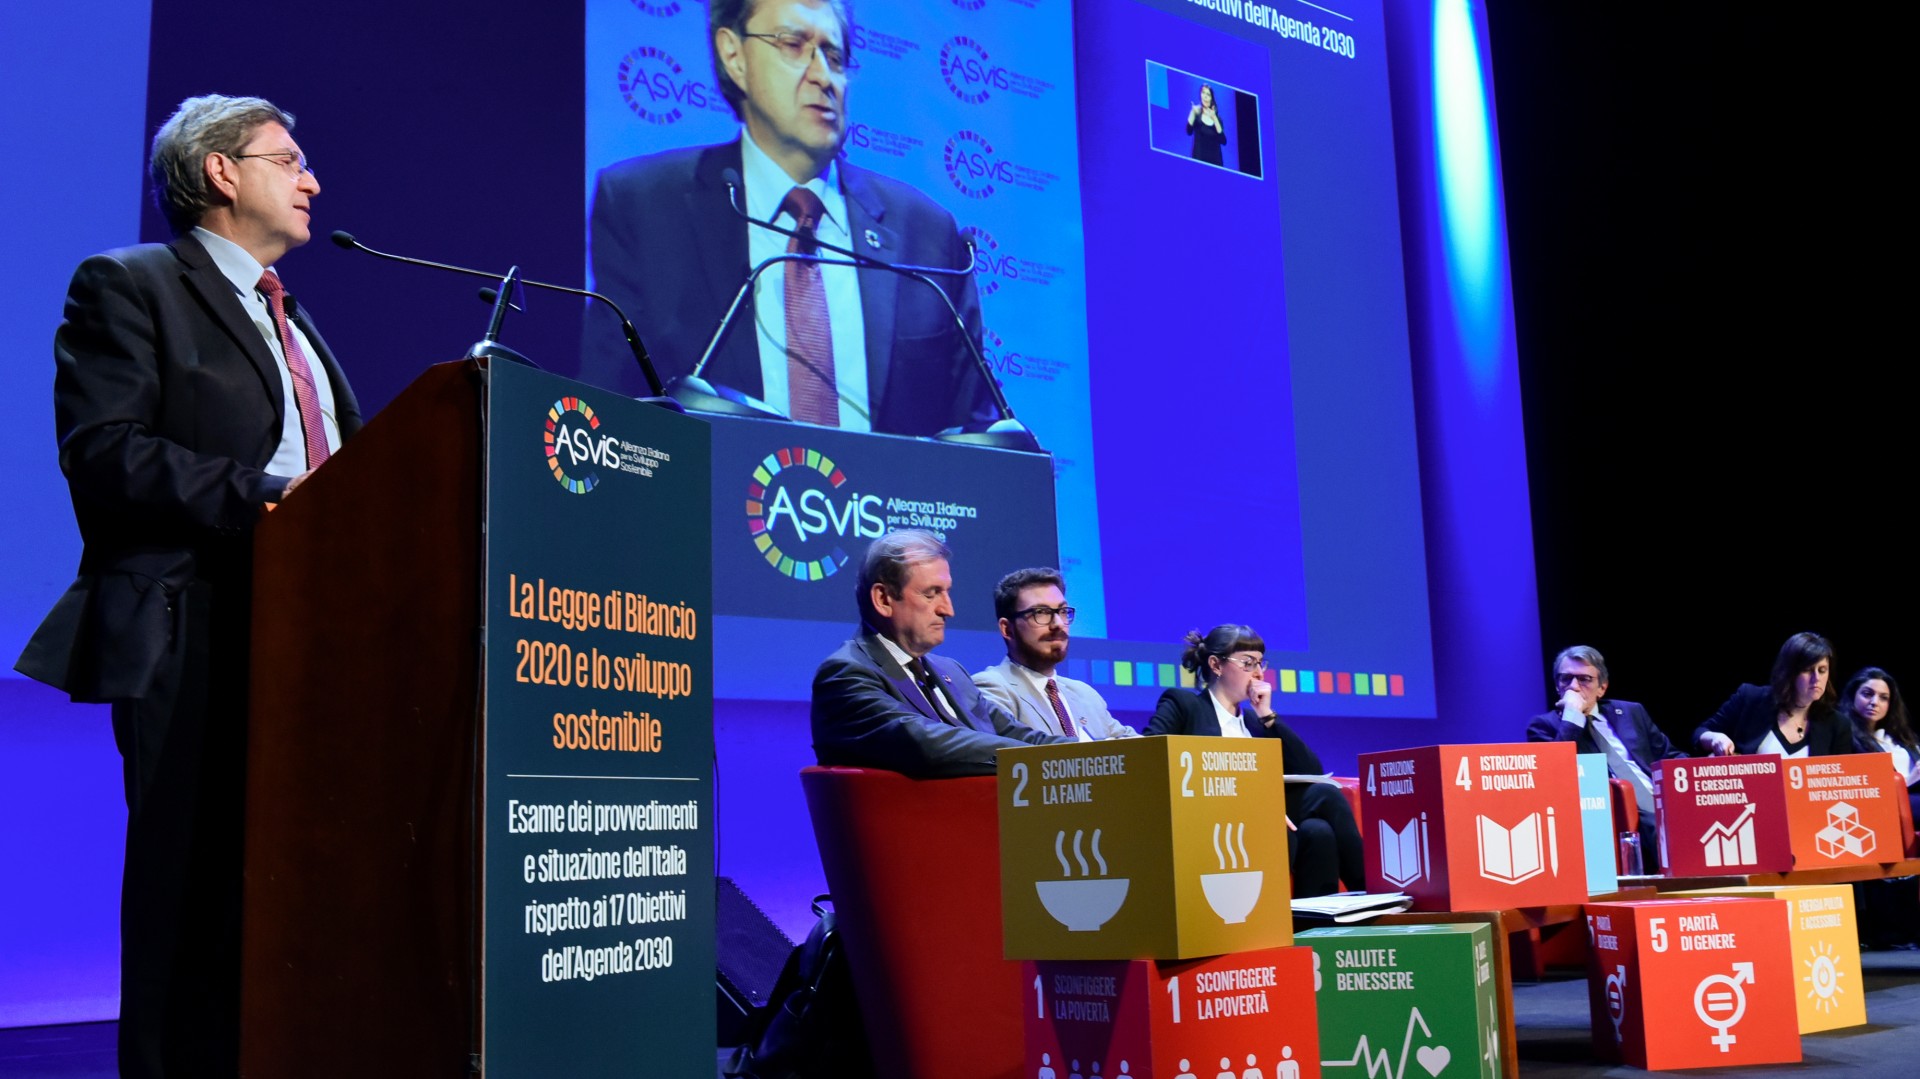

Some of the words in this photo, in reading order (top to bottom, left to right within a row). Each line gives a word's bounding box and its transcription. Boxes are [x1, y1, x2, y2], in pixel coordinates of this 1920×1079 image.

[1244, 0, 1321, 47] dell'Agenda
[1322, 27, 1356, 59] 2030
[974, 249, 1018, 279] SviS
[886, 497, 935, 513] Alleanza
[936, 501, 977, 518] Italiana
[887, 515, 901, 525] per
[902, 516, 909, 525] lo
[910, 513, 957, 530] Sviluppo
[510, 574, 534, 619] La
[538, 578, 600, 631] Legge
[604, 590, 621, 630] di
[625, 592, 696, 640] Bilancio
[516, 639, 571, 686] 2020
[575, 652, 588, 688] e
[592, 647, 610, 689] lo
[614, 652, 691, 700] sviluppo
[553, 709, 662, 753] sostenibile
[1042, 755, 1126, 780] SCONFIGGERE
[1202, 751, 1258, 771] SCONFIGGERE
[1380, 760, 1416, 778] ISTRUZIONE
[1480, 754, 1538, 771] ISTRUZIONE
[1693, 765, 1728, 778] LAVORO
[1729, 762, 1776, 776] DIGNITOSO
[1012, 762, 1029, 807] 2
[1180, 751, 1194, 797] 2
[1366, 763, 1377, 797] 4
[1455, 756, 1472, 791] 4
[1482, 775, 1493, 790] DI
[1494, 771, 1535, 791] QUALITÀ
[1674, 767, 1689, 793] 8
[1694, 780, 1701, 792] E
[1701, 778, 1744, 791] CRESCITA
[1789, 766, 1803, 790] 9
[1807, 775, 1862, 788] INNOVAZIONE
[1863, 775, 1869, 785] E
[1042, 785, 1058, 805] LA
[1060, 783, 1092, 804] FAME
[1203, 776, 1214, 797] LA
[1215, 776, 1237, 797] FAME
[1808, 787, 1881, 801] INFRASTRUTTURE
[1696, 792, 1748, 806] ECONOMICA
[508, 800, 565, 833] Esame
[567, 800, 592, 832] dei
[594, 800, 698, 835] provvedimenti
[524, 854, 535, 883] e
[538, 848, 621, 882] situazione
[623, 845, 687, 878] dell'Italia
[525, 897, 590, 936] rispetto
[593, 895, 607, 928] ai
[609, 893, 624, 926] 17
[627, 889, 686, 924] Obiettivi
[1679, 912, 1719, 932] PARITÀ
[1649, 917, 1669, 953] 5
[1681, 936, 1692, 951] DI
[1694, 933, 1737, 950] GENERE
[542, 941, 632, 982] dell'Agenda
[635, 936, 673, 971] 2030
[1335, 949, 1387, 968] SALUTE
[1388, 949, 1397, 967] E
[1055, 975, 1117, 996] SCONFIGGERE
[1196, 966, 1278, 994] SCONFIGGERE
[1337, 971, 1415, 991] BENESSERE
[1034, 975, 1044, 1019] 1
[1167, 976, 1181, 1023] 1
[1197, 999, 1214, 1020] LA
[1215, 989, 1269, 1018] POVERTÀ
[1055, 1000, 1067, 1020] LA
[1068, 1000, 1110, 1022] POVERTÀ
